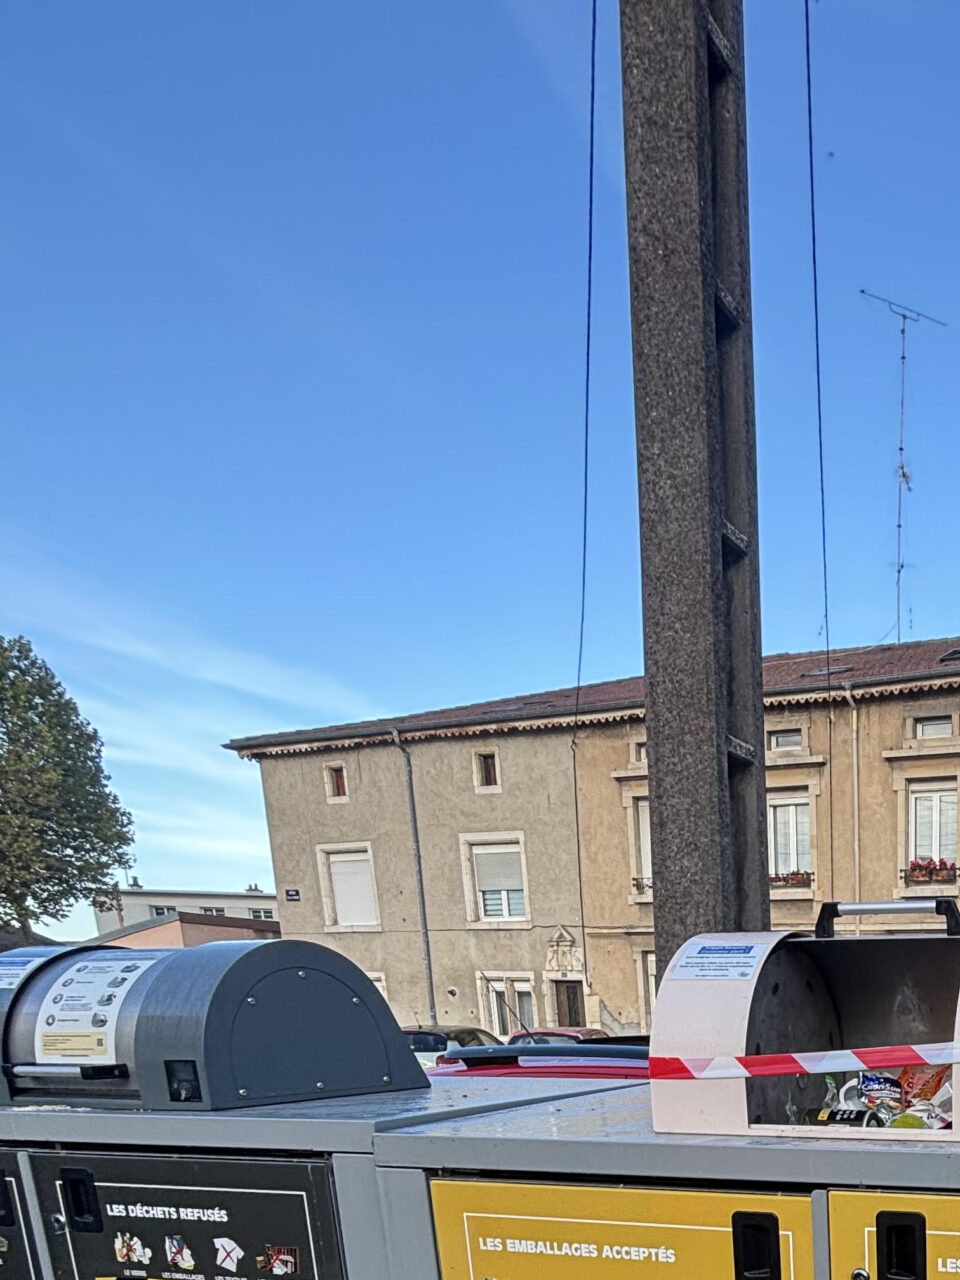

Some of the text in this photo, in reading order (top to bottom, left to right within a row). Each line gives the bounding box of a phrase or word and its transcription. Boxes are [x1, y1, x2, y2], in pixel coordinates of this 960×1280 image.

[106, 1203, 228, 1222] LES DÉCHETS REFUSÉS
[478, 1237, 676, 1262] LES EMBALLAGES ACCEPTÉS
[171, 1273, 205, 1280] EMBALLAGES
